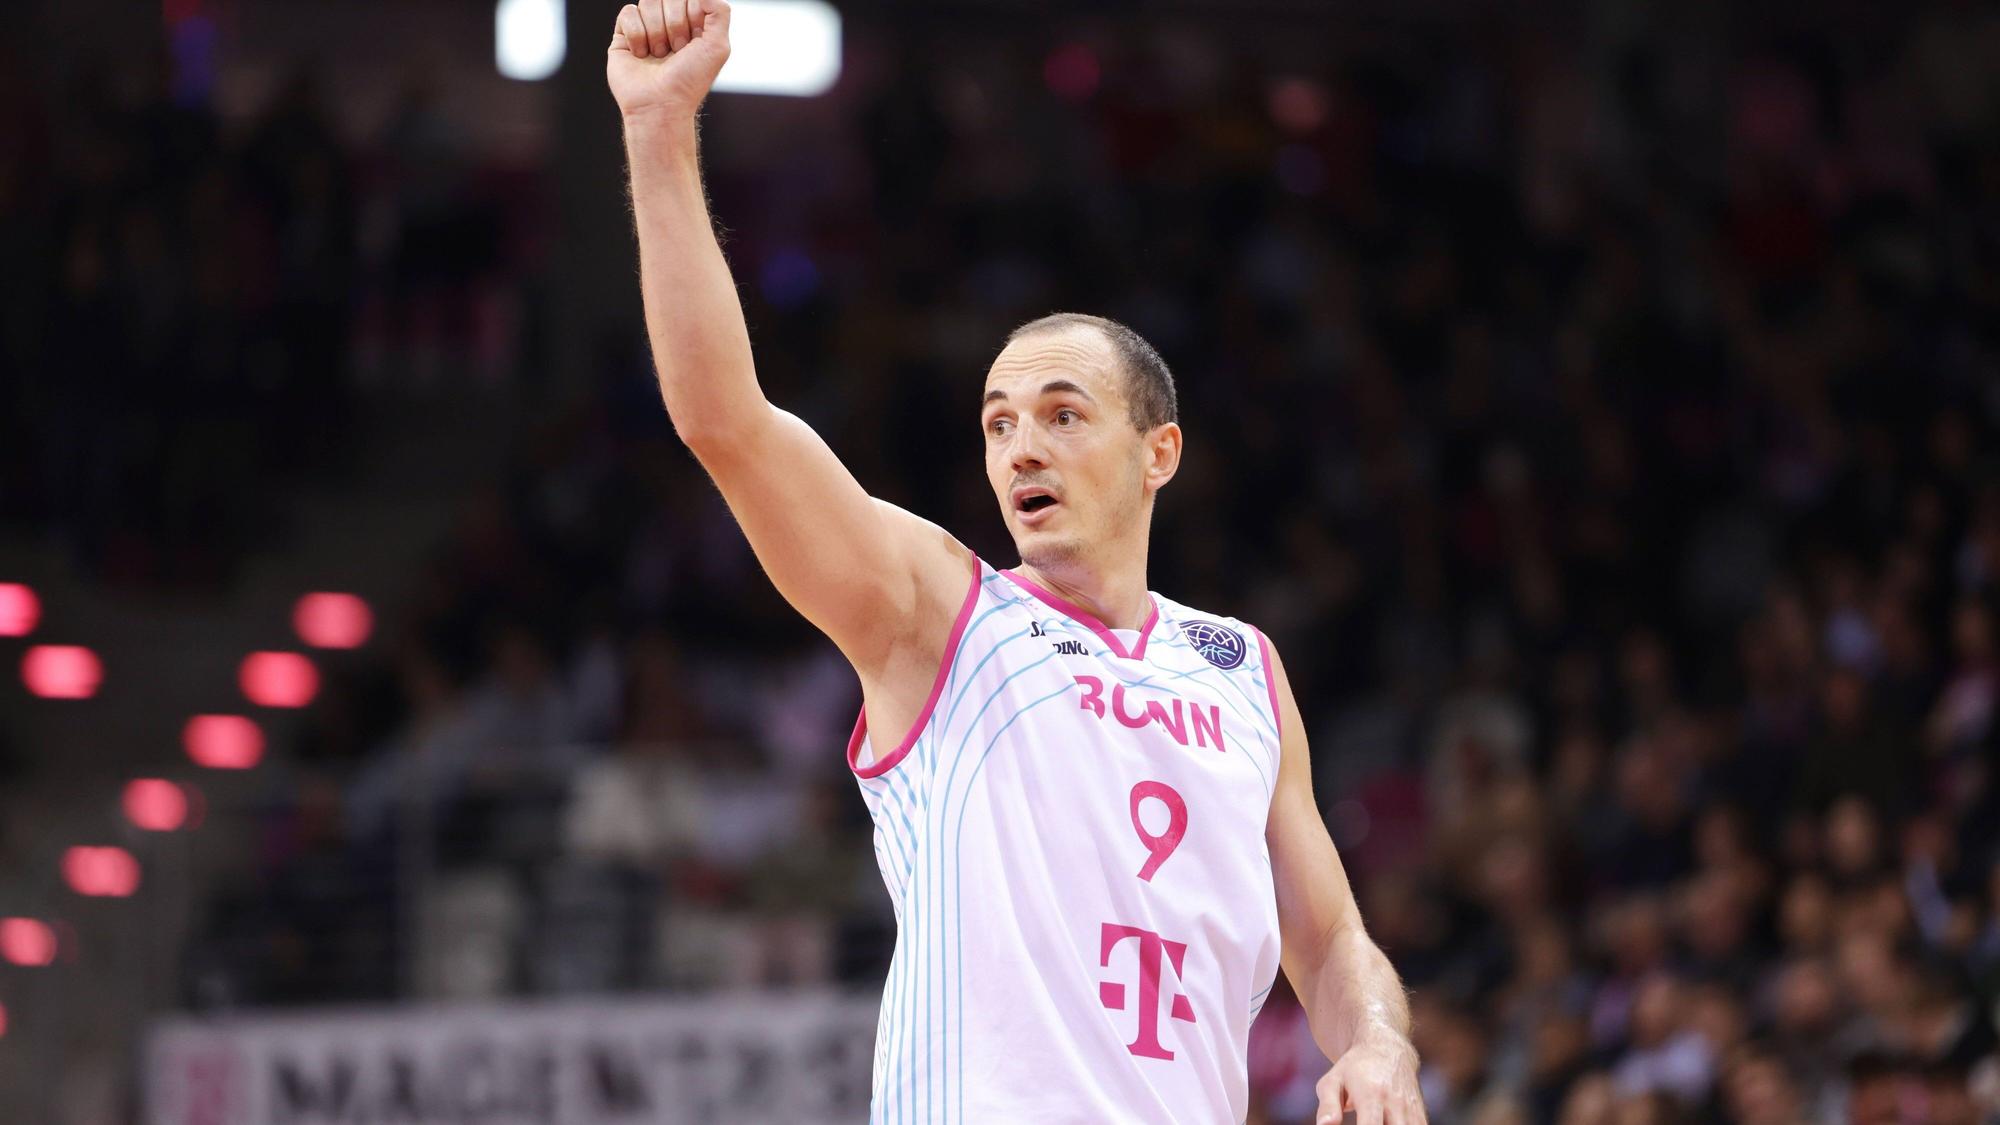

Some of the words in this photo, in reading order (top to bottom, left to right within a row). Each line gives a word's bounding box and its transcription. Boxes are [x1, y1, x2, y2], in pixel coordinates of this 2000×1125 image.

[1073, 675, 1226, 752] BONN
[1130, 780, 1188, 882] 9
[1100, 922, 1197, 1061] T
